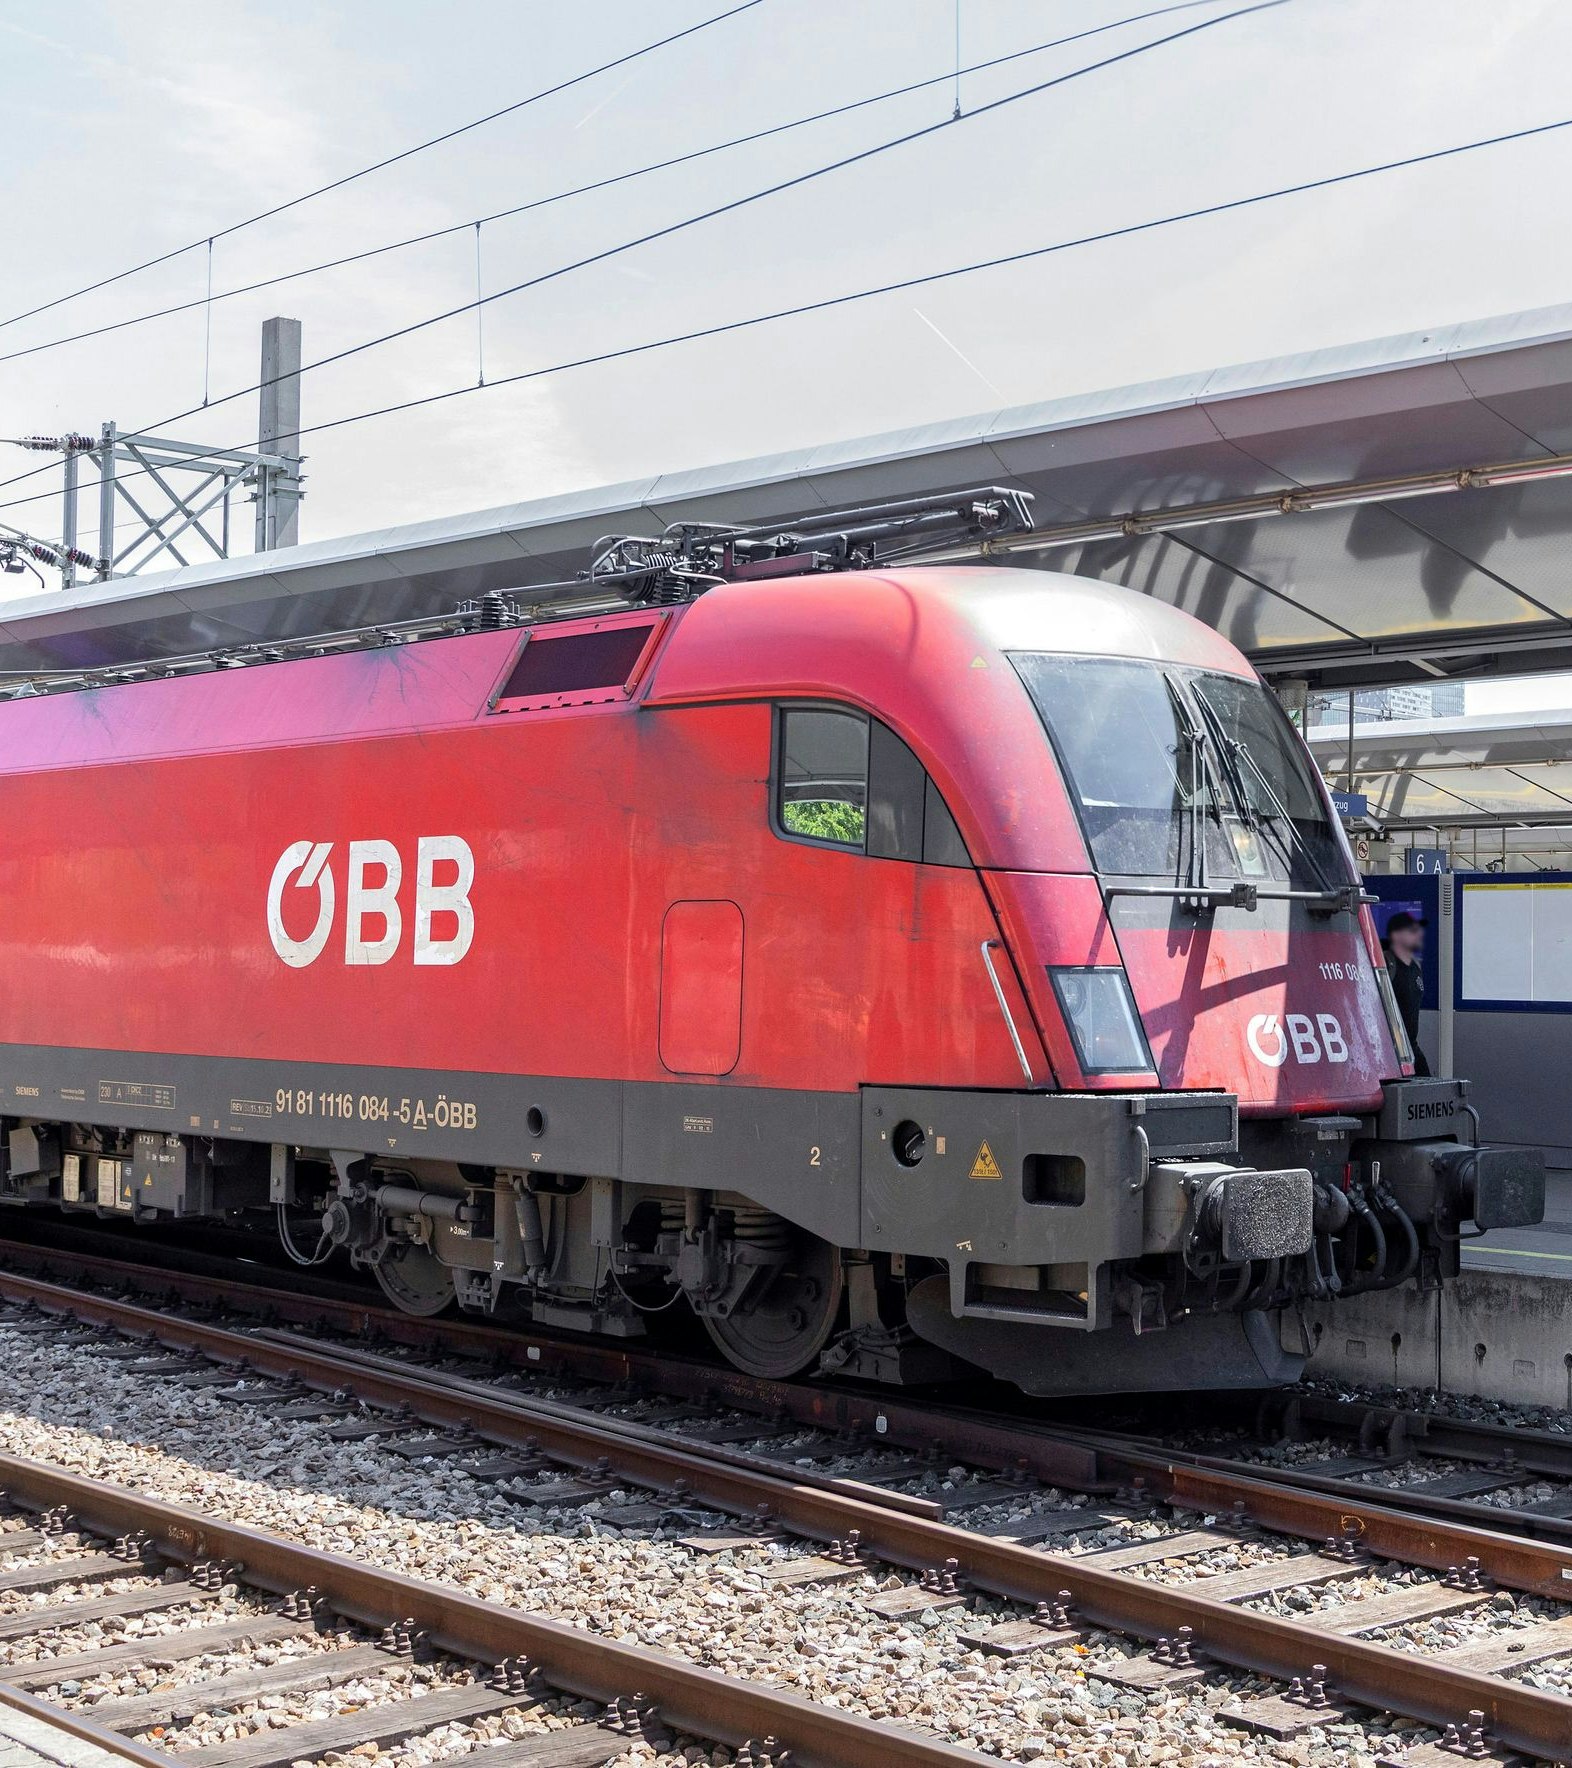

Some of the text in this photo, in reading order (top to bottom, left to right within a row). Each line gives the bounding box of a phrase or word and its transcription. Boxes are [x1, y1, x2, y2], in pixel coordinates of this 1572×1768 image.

[1333, 801, 1349, 813] zug
[1416, 853, 1425, 874] 6
[1433, 859, 1443, 875] A
[266, 834, 476, 969] ÖBB
[1319, 962, 1344, 980] 1116
[1246, 1013, 1349, 1068] ÖBB
[15, 1085, 40, 1097] SIEMENS
[276, 1088, 292, 1113] 91
[296, 1090, 314, 1115] 81
[319, 1092, 353, 1119] 1116
[1407, 1100, 1454, 1121] SIEMENS
[810, 1146, 821, 1166] 2
